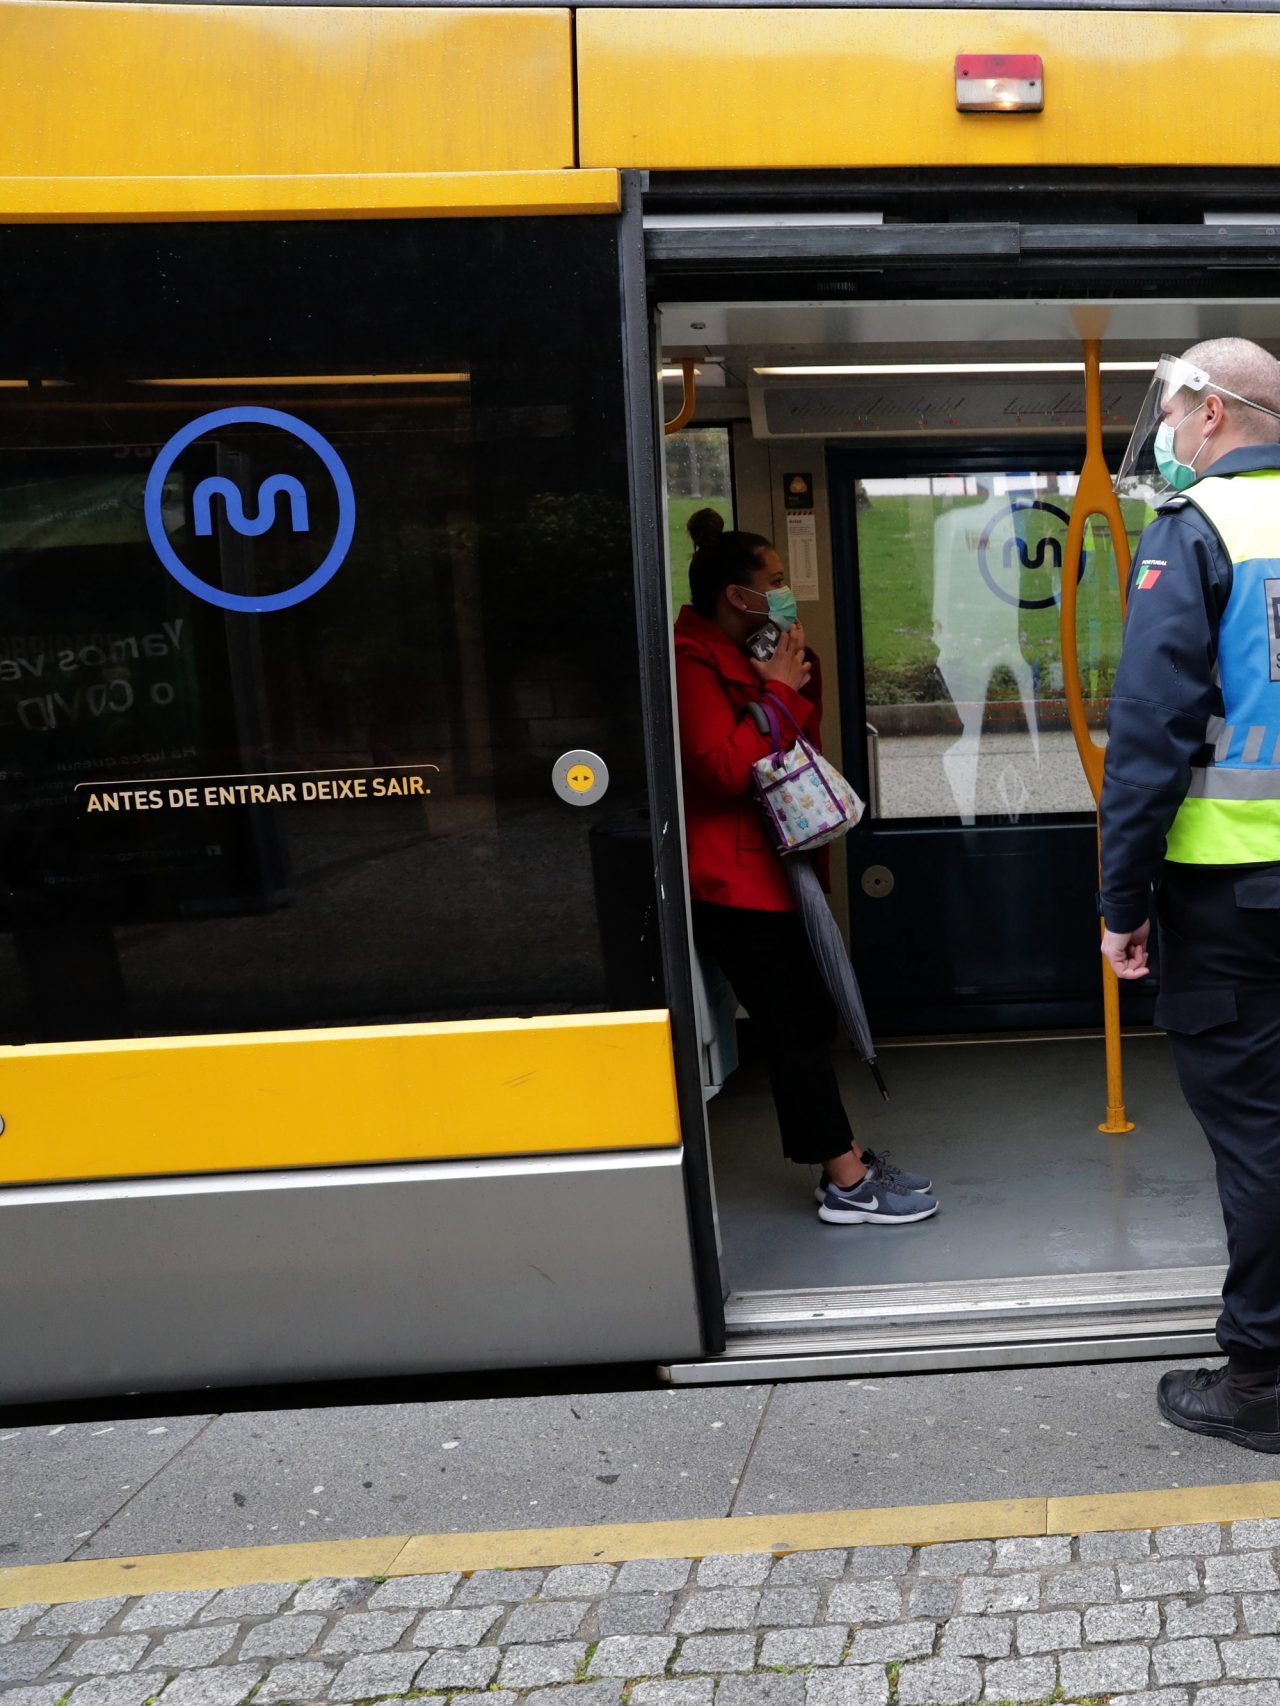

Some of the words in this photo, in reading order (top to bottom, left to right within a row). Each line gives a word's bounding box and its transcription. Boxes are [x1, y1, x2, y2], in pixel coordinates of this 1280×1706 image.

[87, 789, 163, 813] ANTES
[169, 788, 200, 808] DE
[205, 783, 298, 807] ENTRAR
[302, 777, 368, 801] DEIXE
[373, 776, 431, 798] SAIR.
